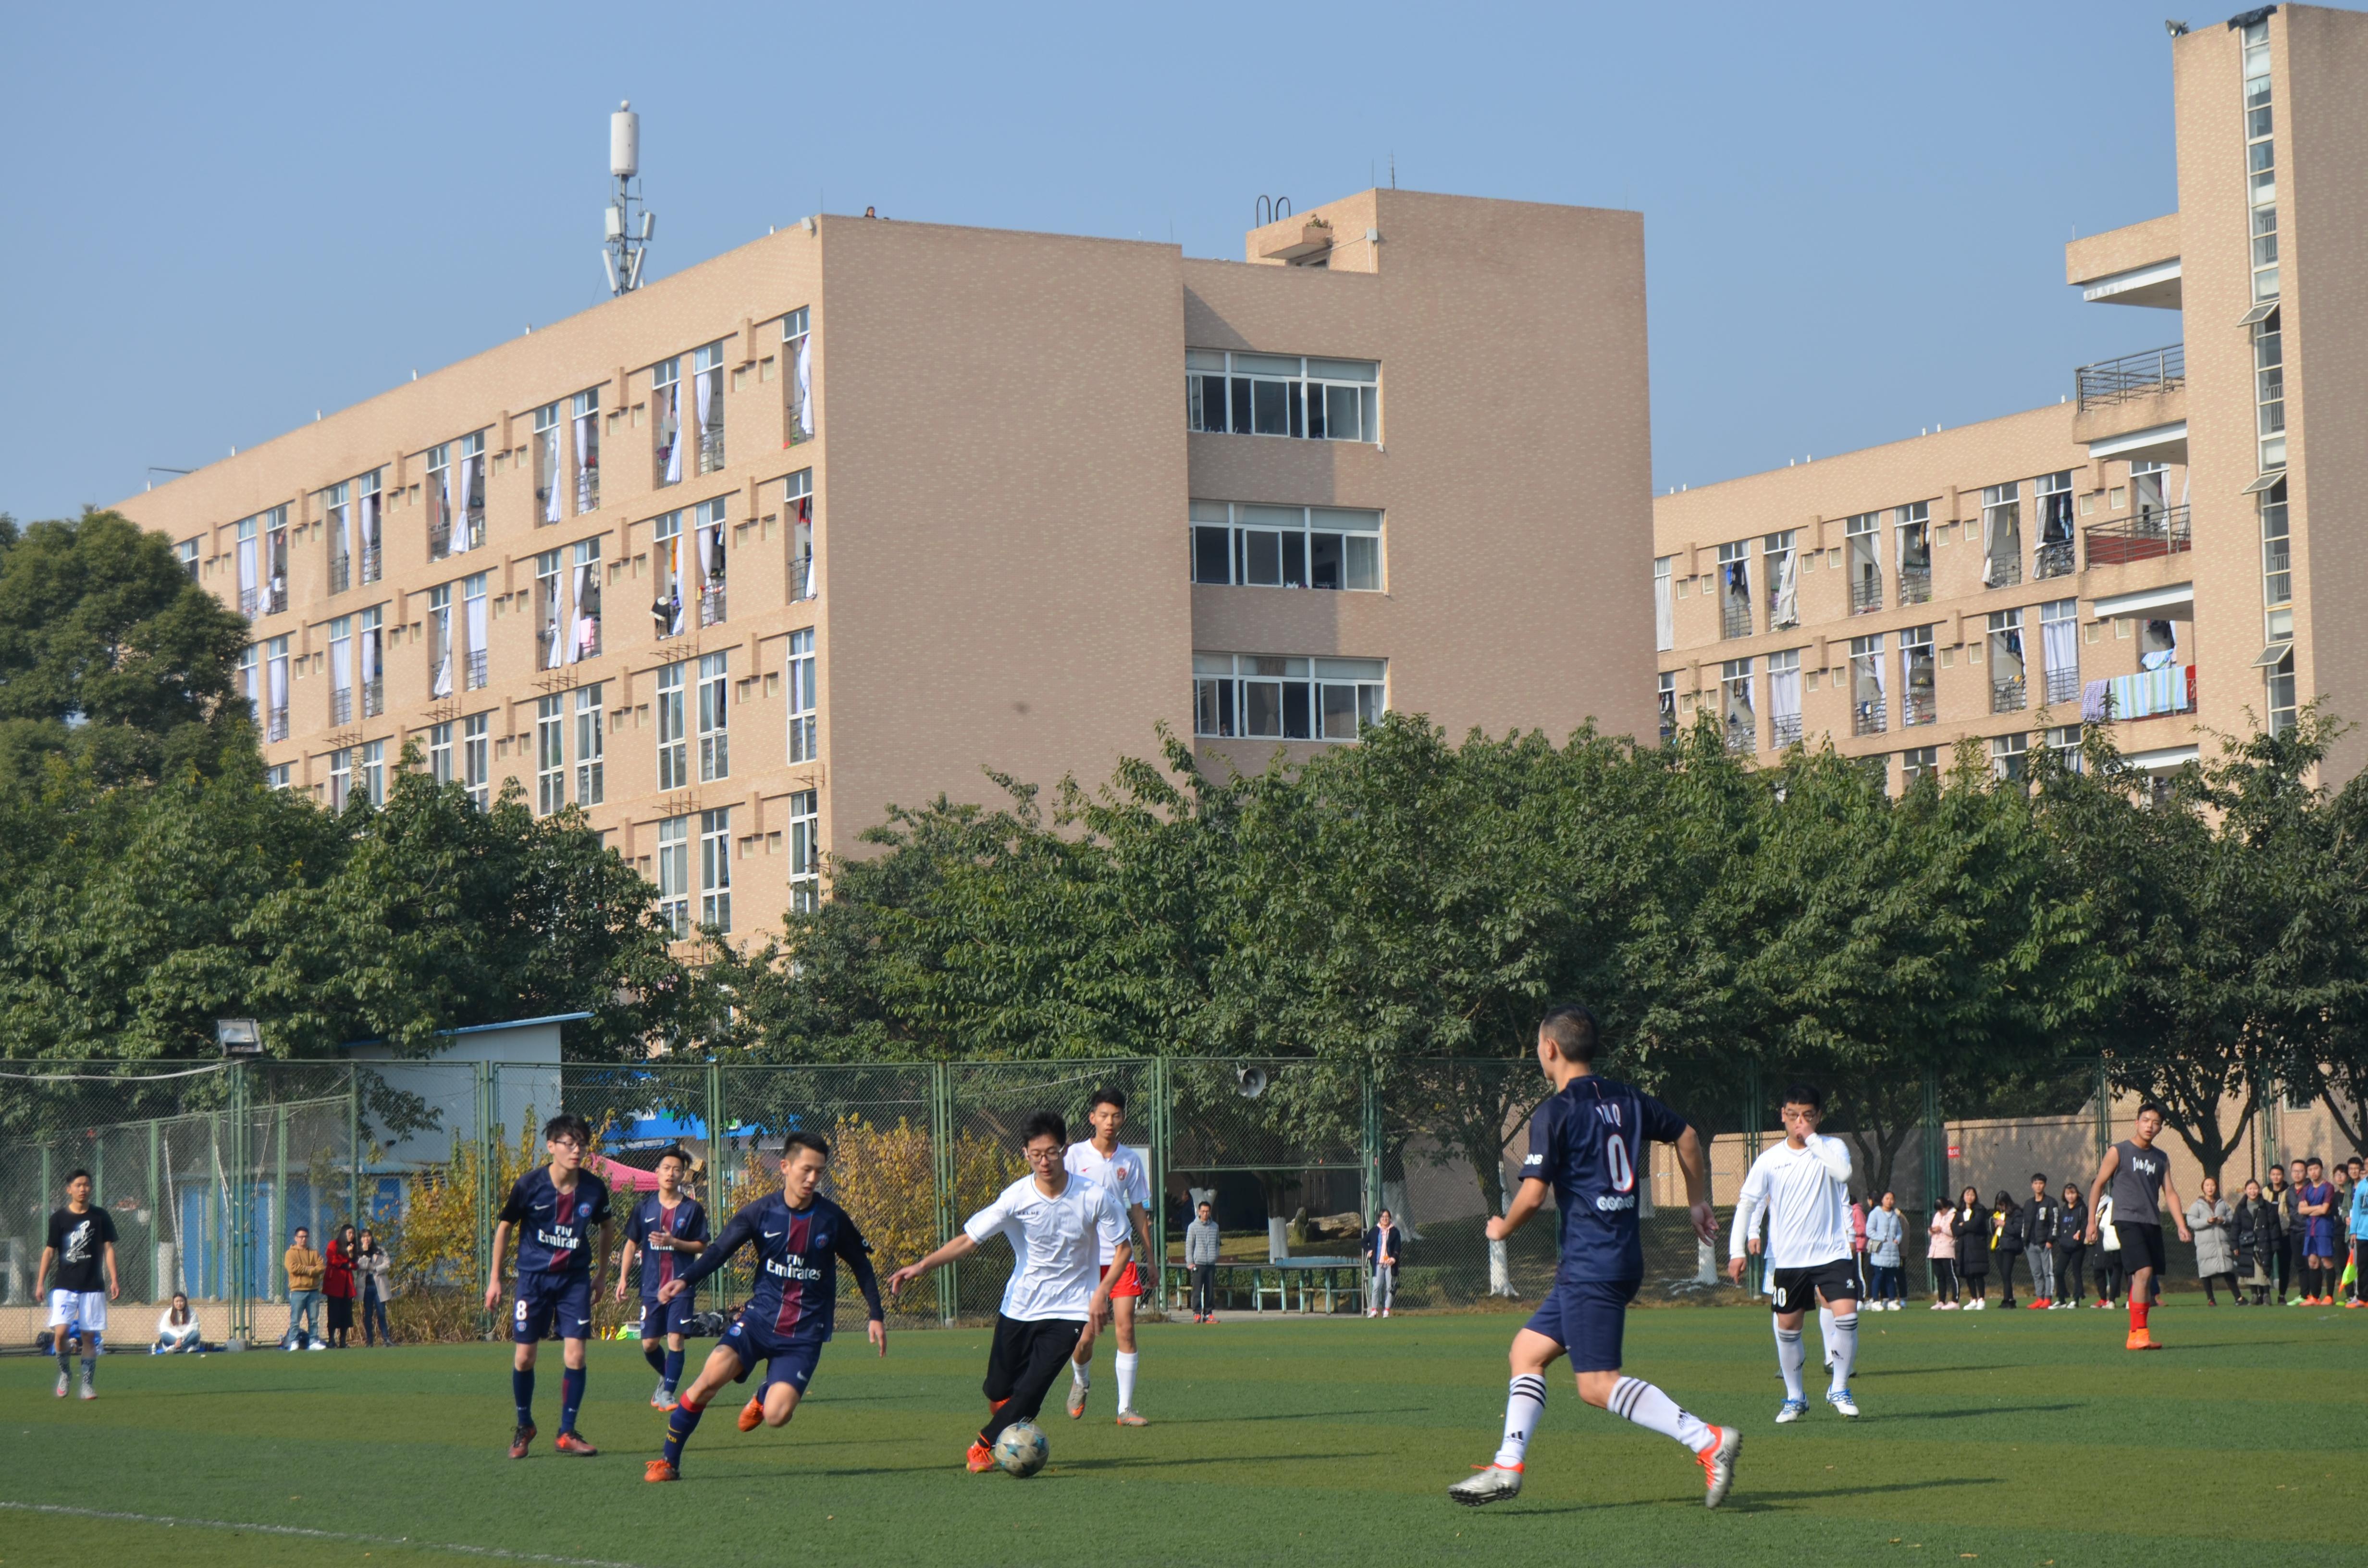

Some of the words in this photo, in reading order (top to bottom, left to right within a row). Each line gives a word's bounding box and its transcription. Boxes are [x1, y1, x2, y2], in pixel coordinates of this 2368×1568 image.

[1608, 1134, 1633, 1192] 0
[538, 1228, 580, 1249] Emirat
[555, 1225, 572, 1237] Fly
[766, 1258, 821, 1280] Emirates
[787, 1254, 804, 1267] Fly
[61, 1304, 66, 1315] 7
[516, 1300, 527, 1320] 8
